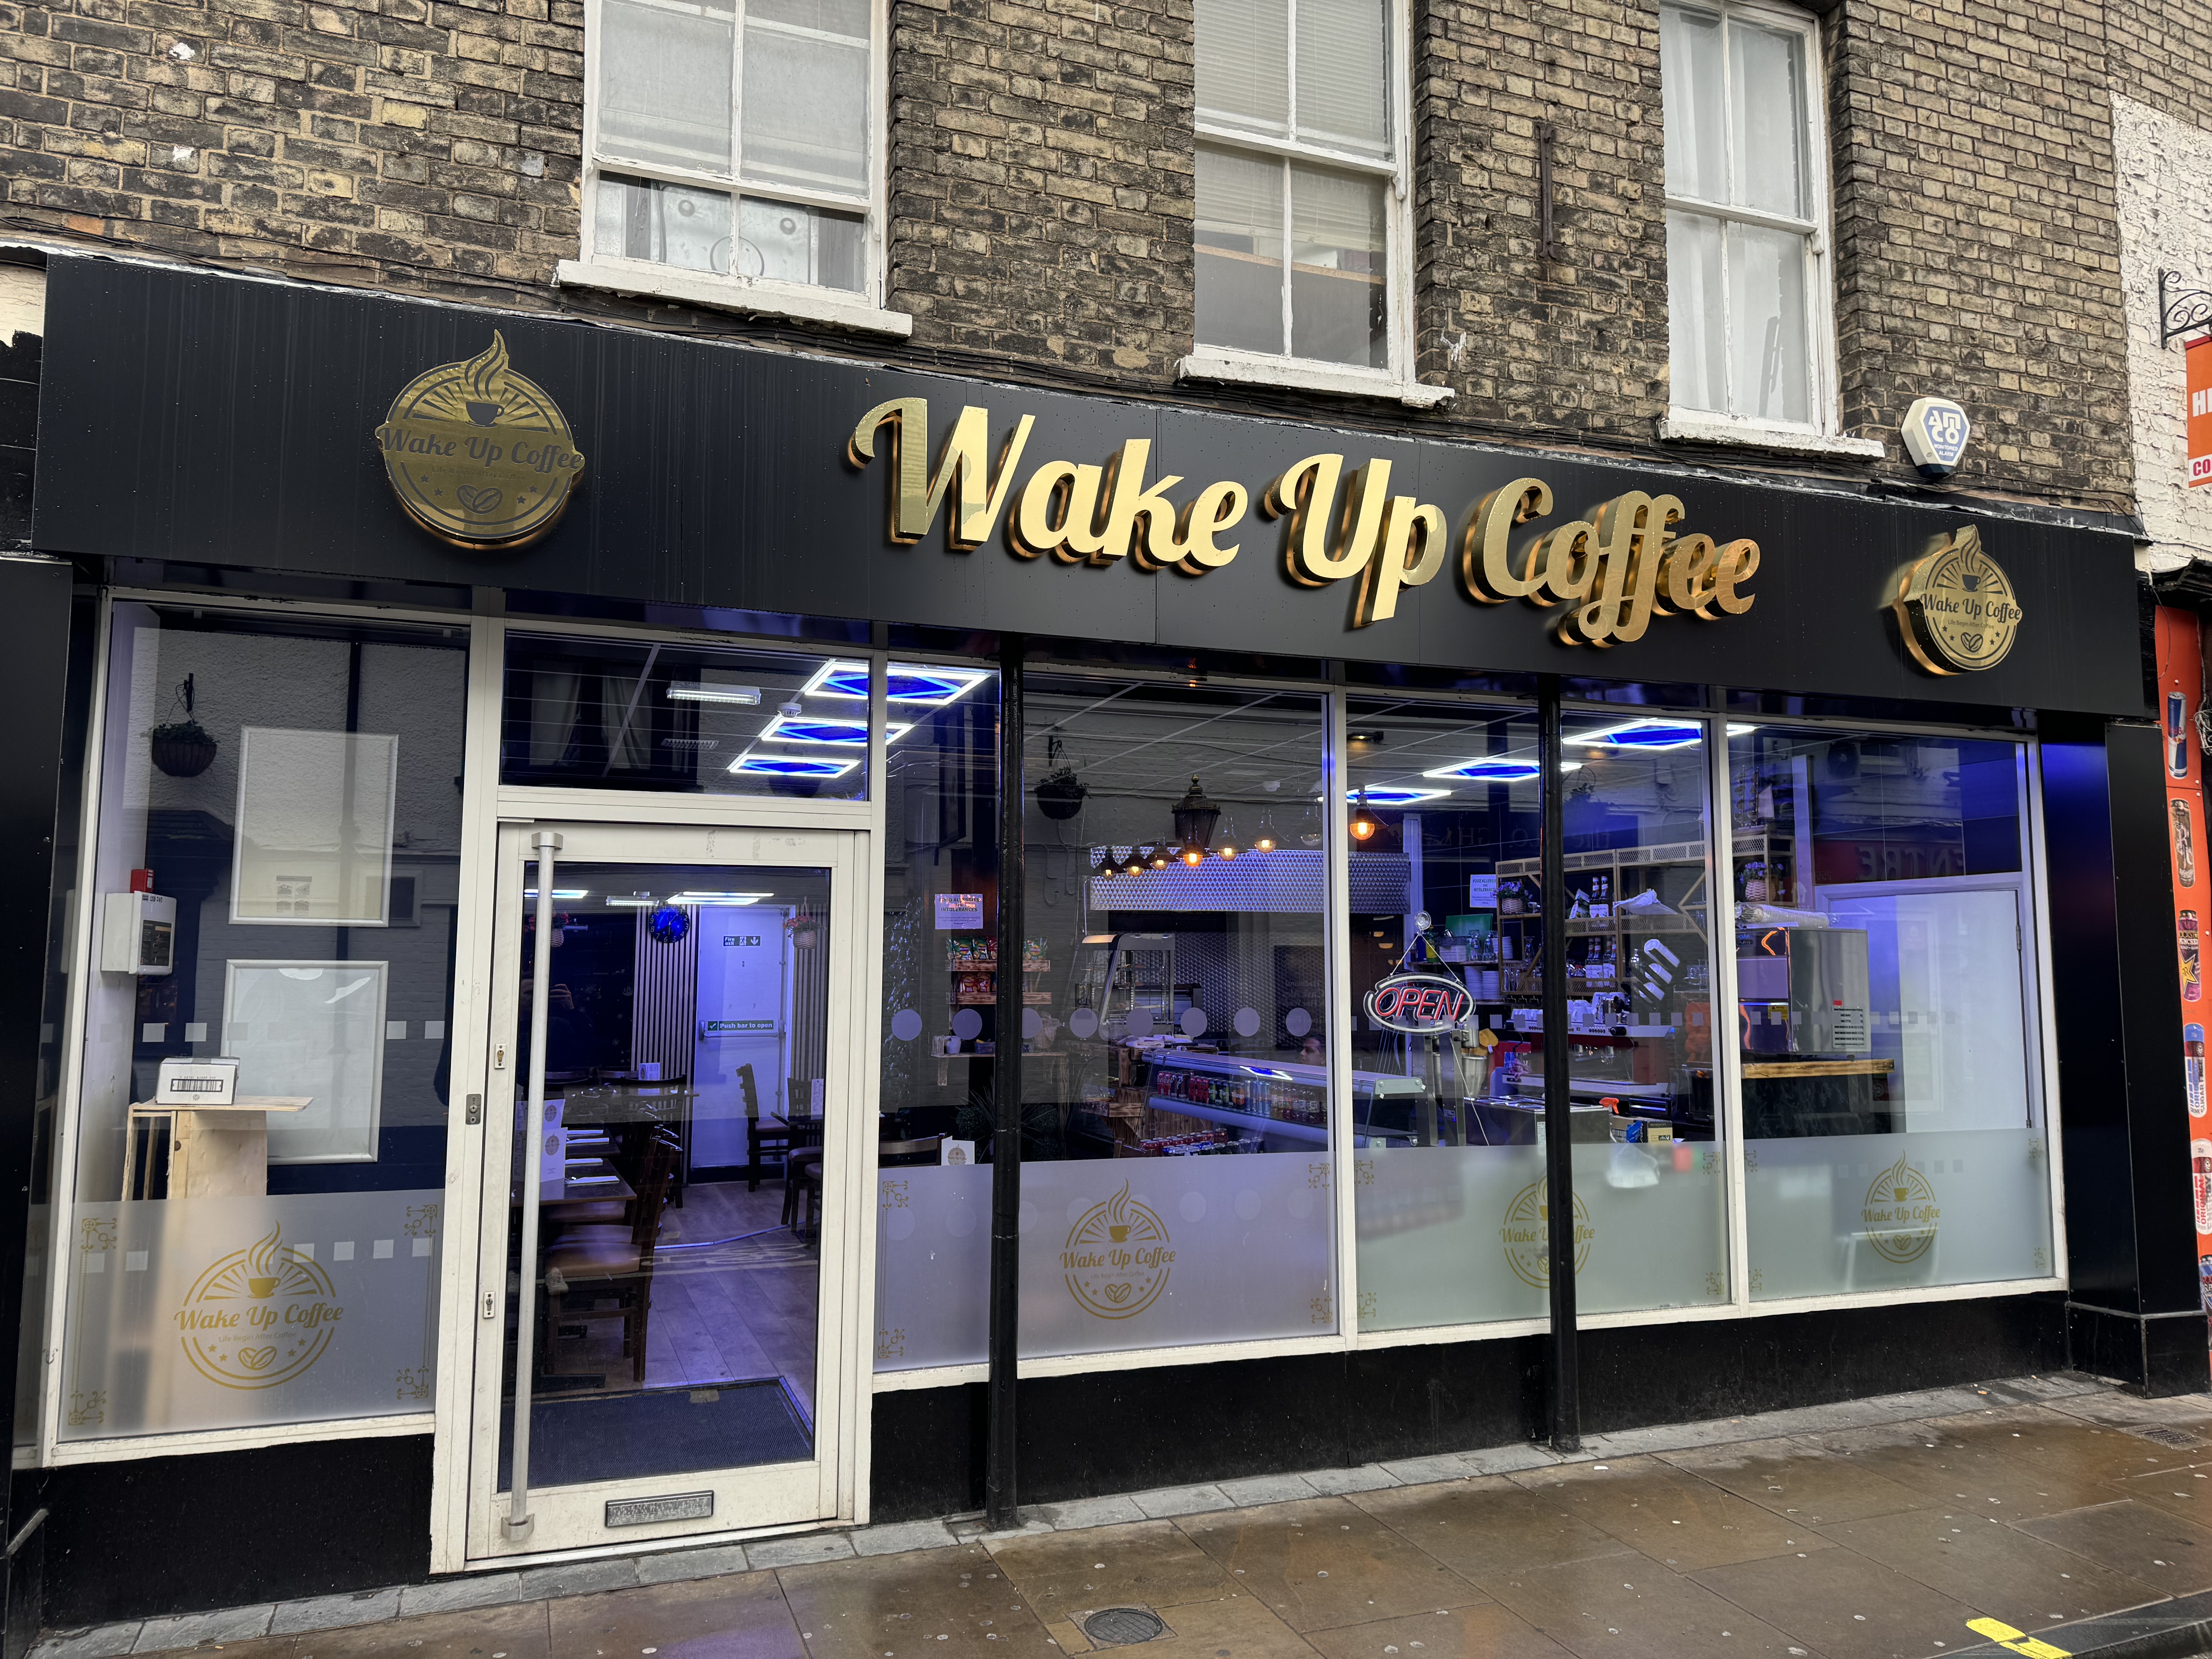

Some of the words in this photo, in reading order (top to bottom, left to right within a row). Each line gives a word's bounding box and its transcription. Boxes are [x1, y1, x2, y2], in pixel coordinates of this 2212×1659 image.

[376, 427, 457, 457] Wake
[464, 436, 503, 468] Up
[511, 441, 582, 474] Coffee
[854, 397, 1249, 567] Wake
[1279, 453, 1447, 622] Up
[1483, 477, 1760, 642] Coffee
[1920, 593, 1959, 613] Wake
[1963, 598, 1982, 620] Up
[1986, 601, 2020, 623] Coffee
[1375, 987, 1465, 1021] OPEN
[1861, 1209, 1893, 1223] Wake
[1894, 1207, 1910, 1224] Up
[1913, 1205, 1940, 1223] Coffee
[1499, 1227, 1537, 1243] Wake
[1059, 1251, 1105, 1269] Wake
[1109, 1249, 1131, 1270] Up
[1135, 1247, 1176, 1269] Coffee
[174, 1310, 240, 1331] Wake
[246, 1305, 278, 1331] Up
[284, 1302, 343, 1329] Coffee
